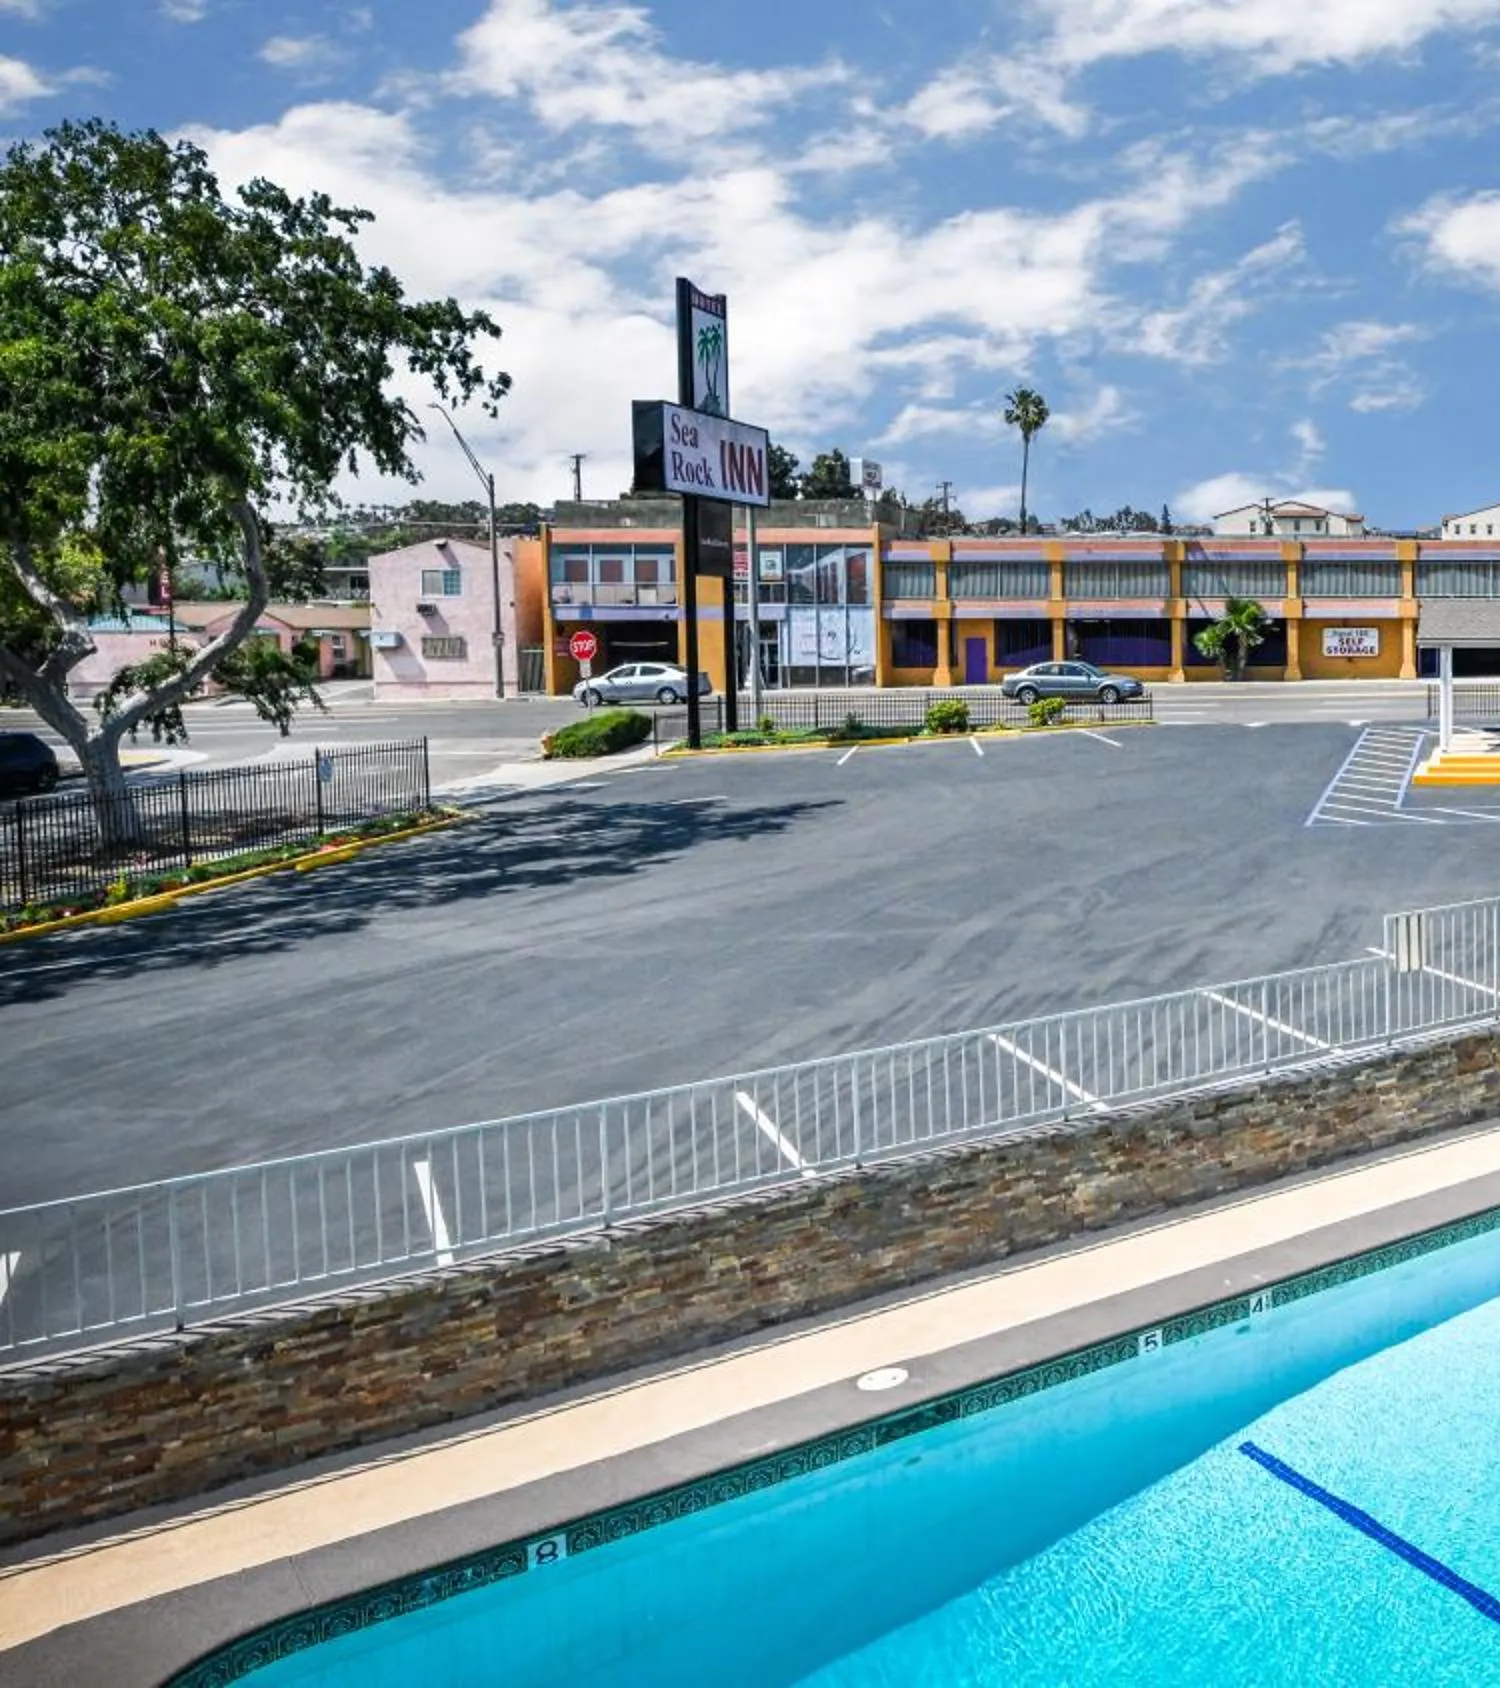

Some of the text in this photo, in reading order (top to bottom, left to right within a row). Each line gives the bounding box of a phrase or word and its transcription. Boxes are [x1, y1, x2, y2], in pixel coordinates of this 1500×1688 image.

[671, 413, 699, 449] Sea
[672, 451, 715, 488] Rock
[720, 440, 763, 496] INN
[573, 639, 593, 653] STOP
[1326, 646, 1376, 654] STORAGE
[1338, 637, 1364, 645] SELF
[1144, 1333, 1159, 1353] 5
[536, 1540, 559, 1565] 8
